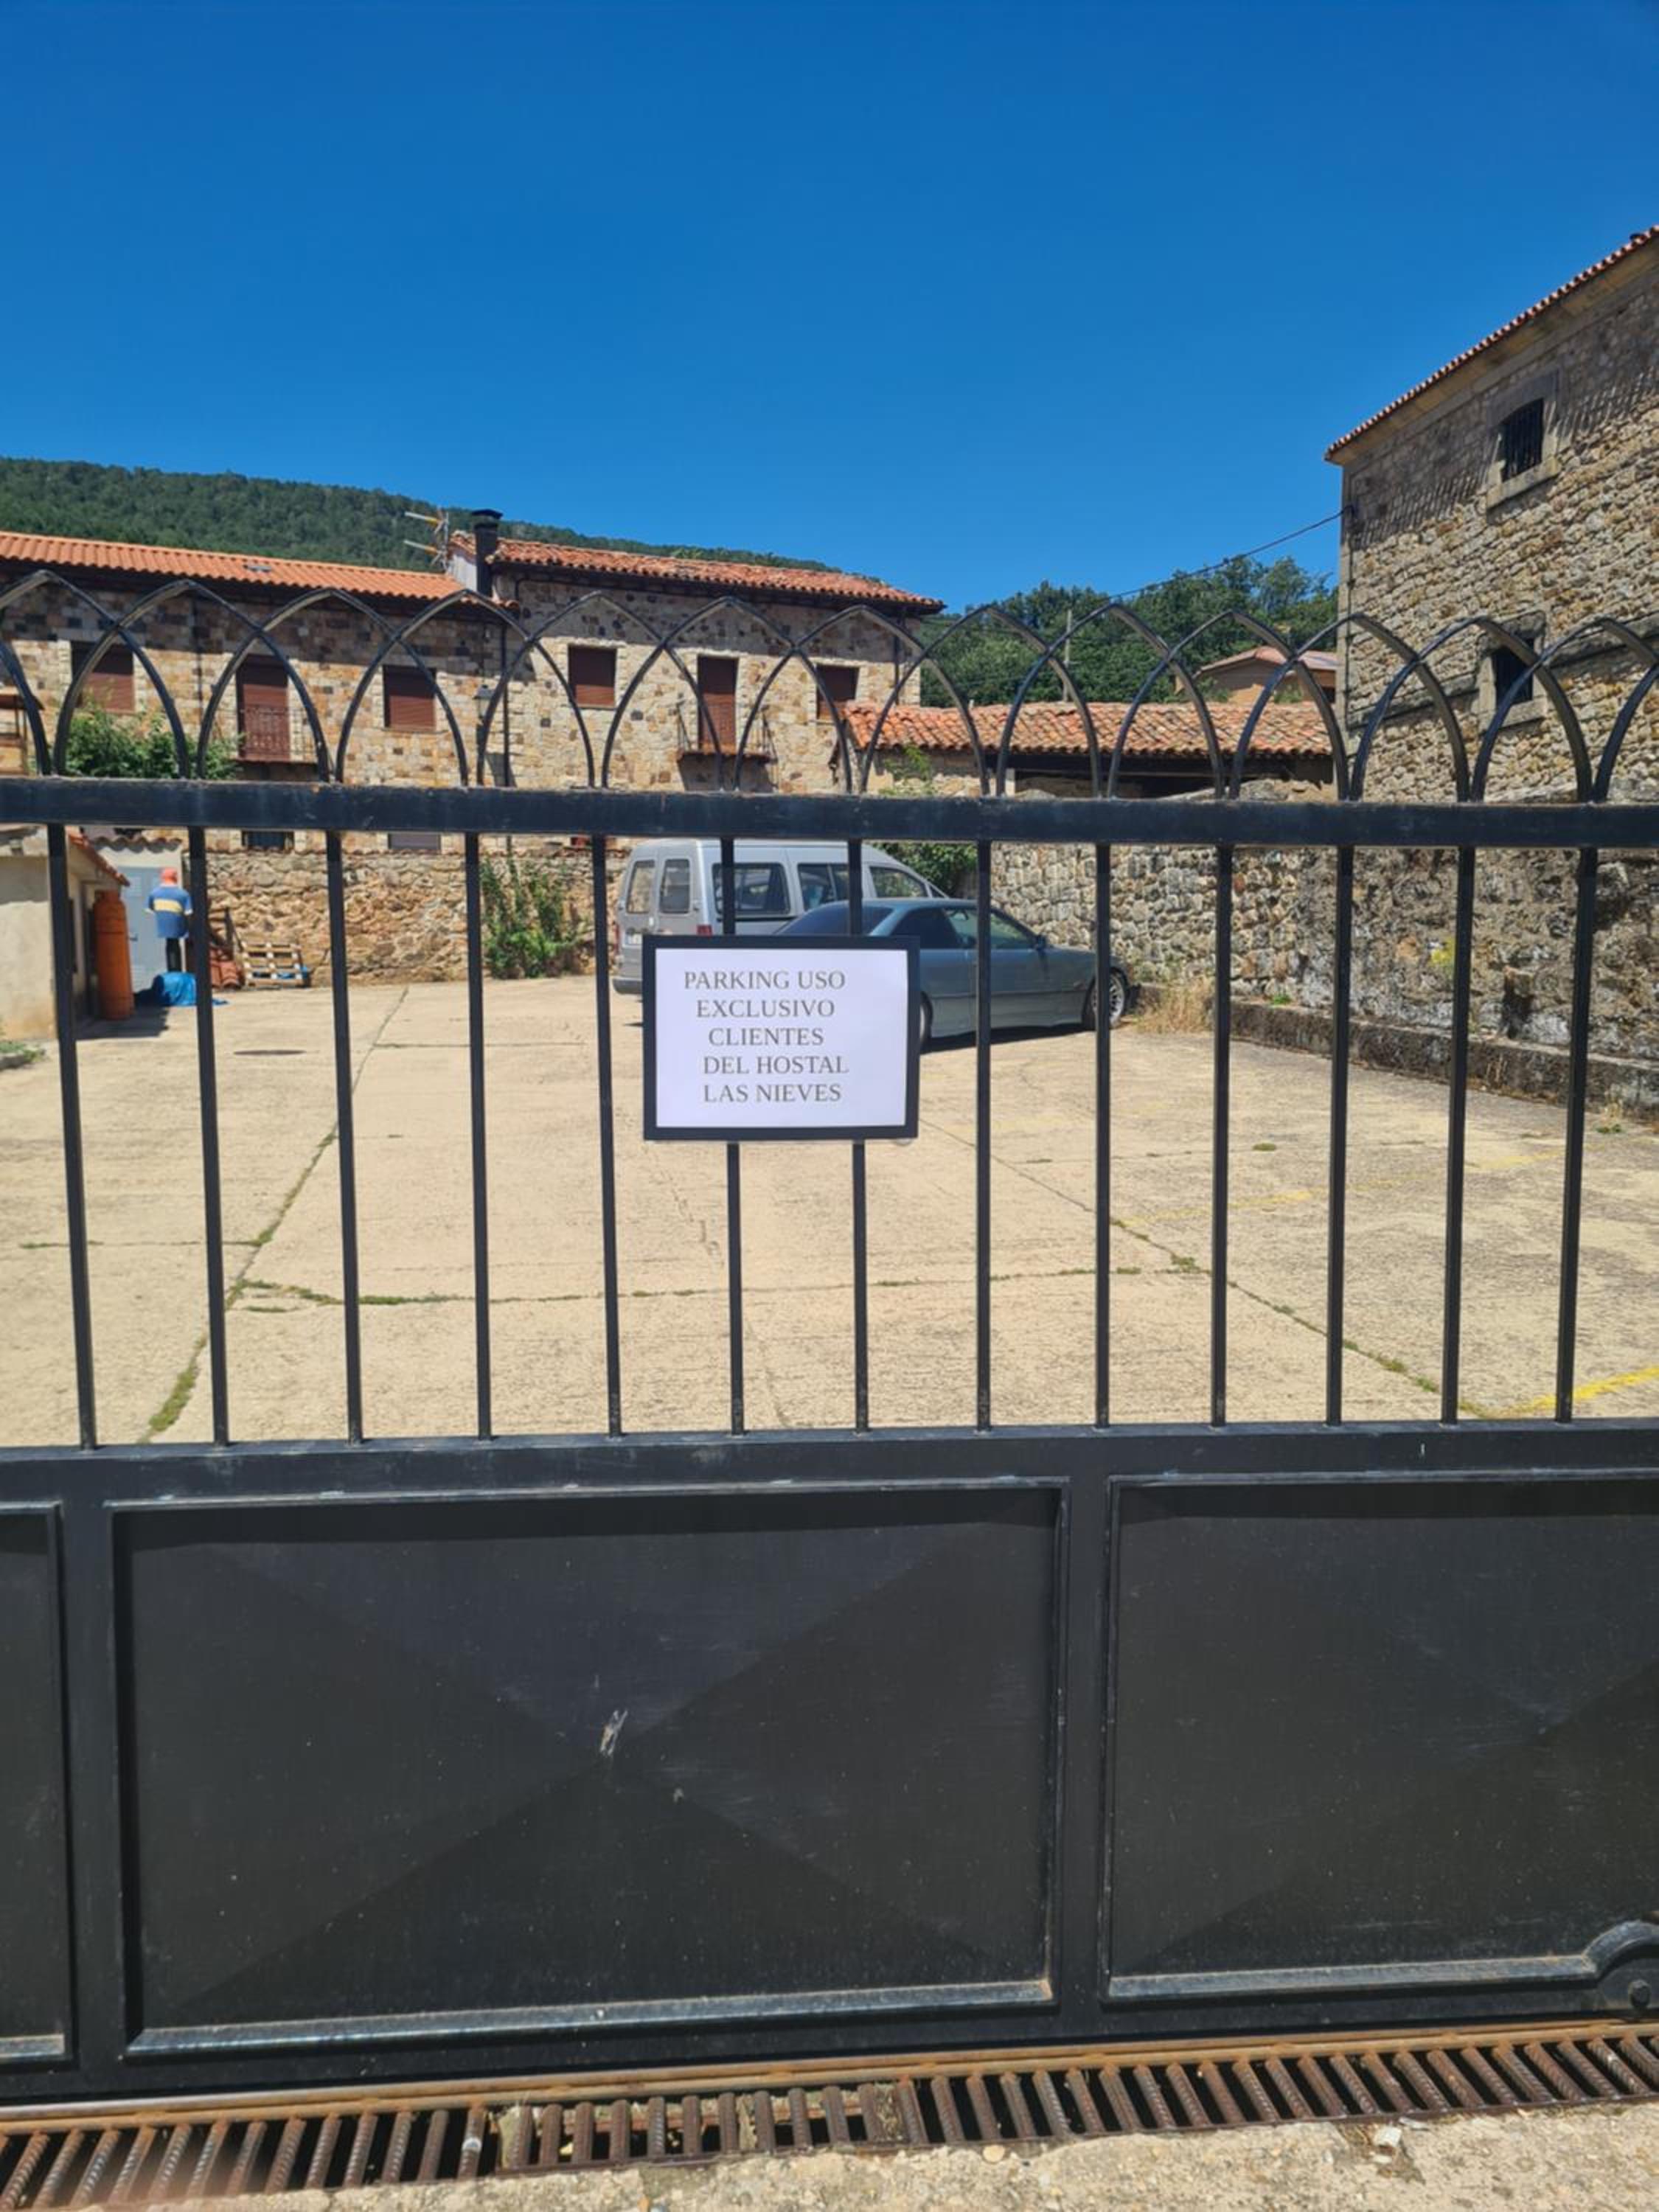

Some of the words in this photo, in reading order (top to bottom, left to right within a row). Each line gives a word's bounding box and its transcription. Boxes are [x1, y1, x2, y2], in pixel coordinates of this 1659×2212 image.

[684, 971, 789, 990] PARKING
[798, 971, 846, 990] USO
[697, 1000, 835, 1018] EXCLUSIVO
[708, 1028, 824, 1046] CLIENTES
[703, 1057, 749, 1074] DEL
[757, 1056, 849, 1074] HOSTAL
[703, 1085, 749, 1102] LAS
[756, 1084, 842, 1102] NIEVES
